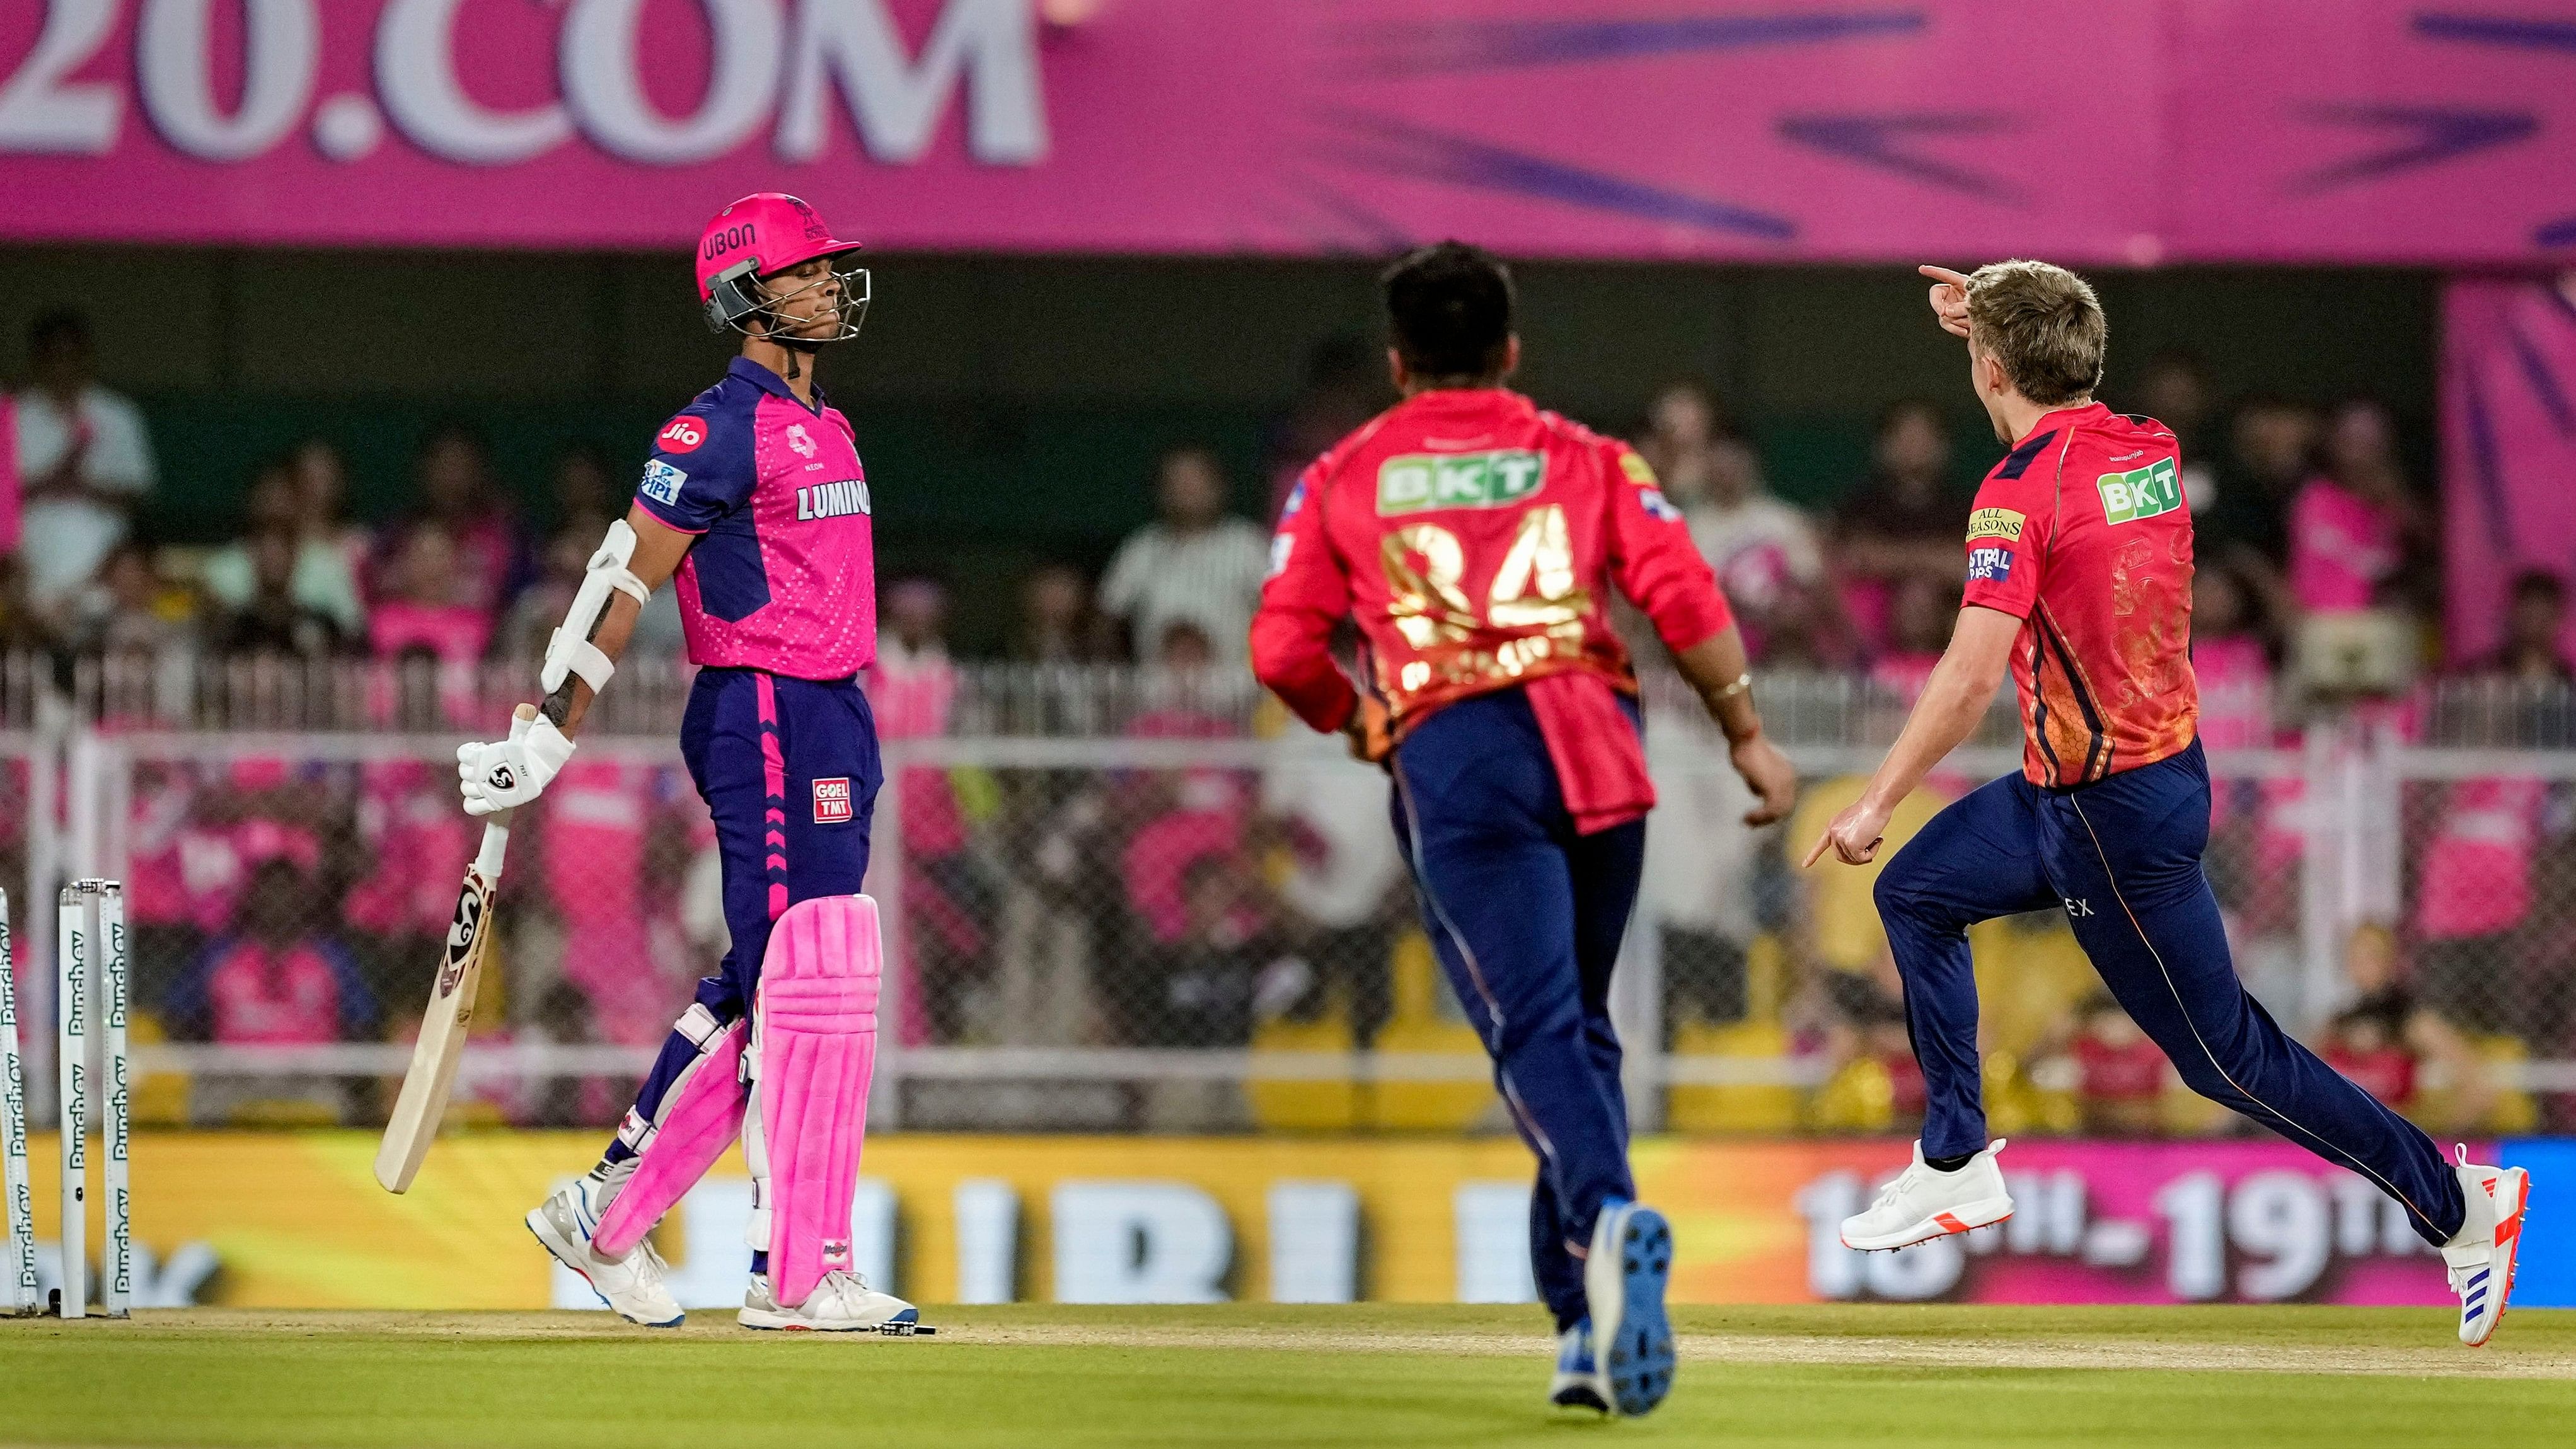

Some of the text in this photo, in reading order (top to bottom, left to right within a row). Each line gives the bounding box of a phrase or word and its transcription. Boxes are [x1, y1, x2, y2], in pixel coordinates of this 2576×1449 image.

[703, 223, 756, 260] UBON
[661, 423, 700, 445] Jio
[648, 479, 672, 502] IPL
[1384, 459, 1538, 500] BKT
[2103, 468, 2174, 513] BKT
[1979, 509, 2003, 519] ALL
[816, 783, 848, 798] GOEL
[821, 800, 846, 816] TMT
